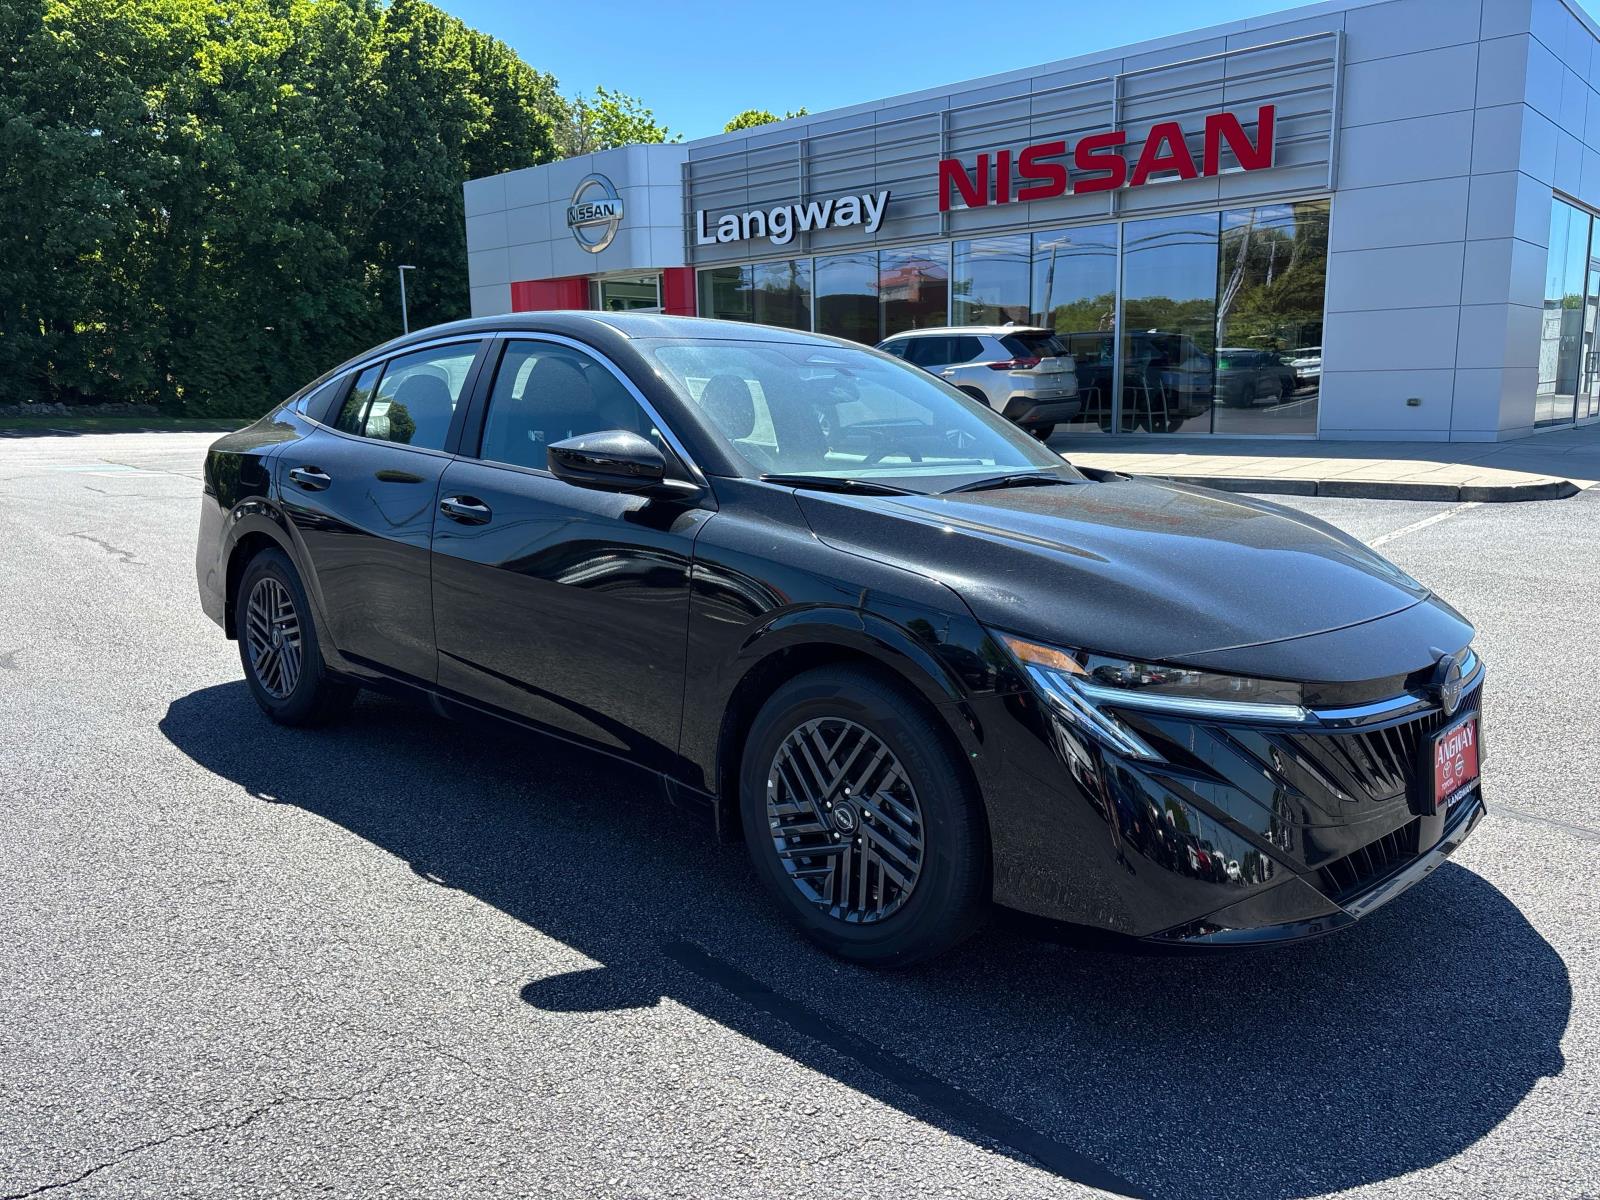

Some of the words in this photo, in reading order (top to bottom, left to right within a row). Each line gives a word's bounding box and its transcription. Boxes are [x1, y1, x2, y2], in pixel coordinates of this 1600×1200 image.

[939, 105, 1275, 212] NISSAN
[569, 203, 615, 222] NISSAN
[697, 190, 892, 245] Langway
[1436, 725, 1474, 769] ANGWAY
